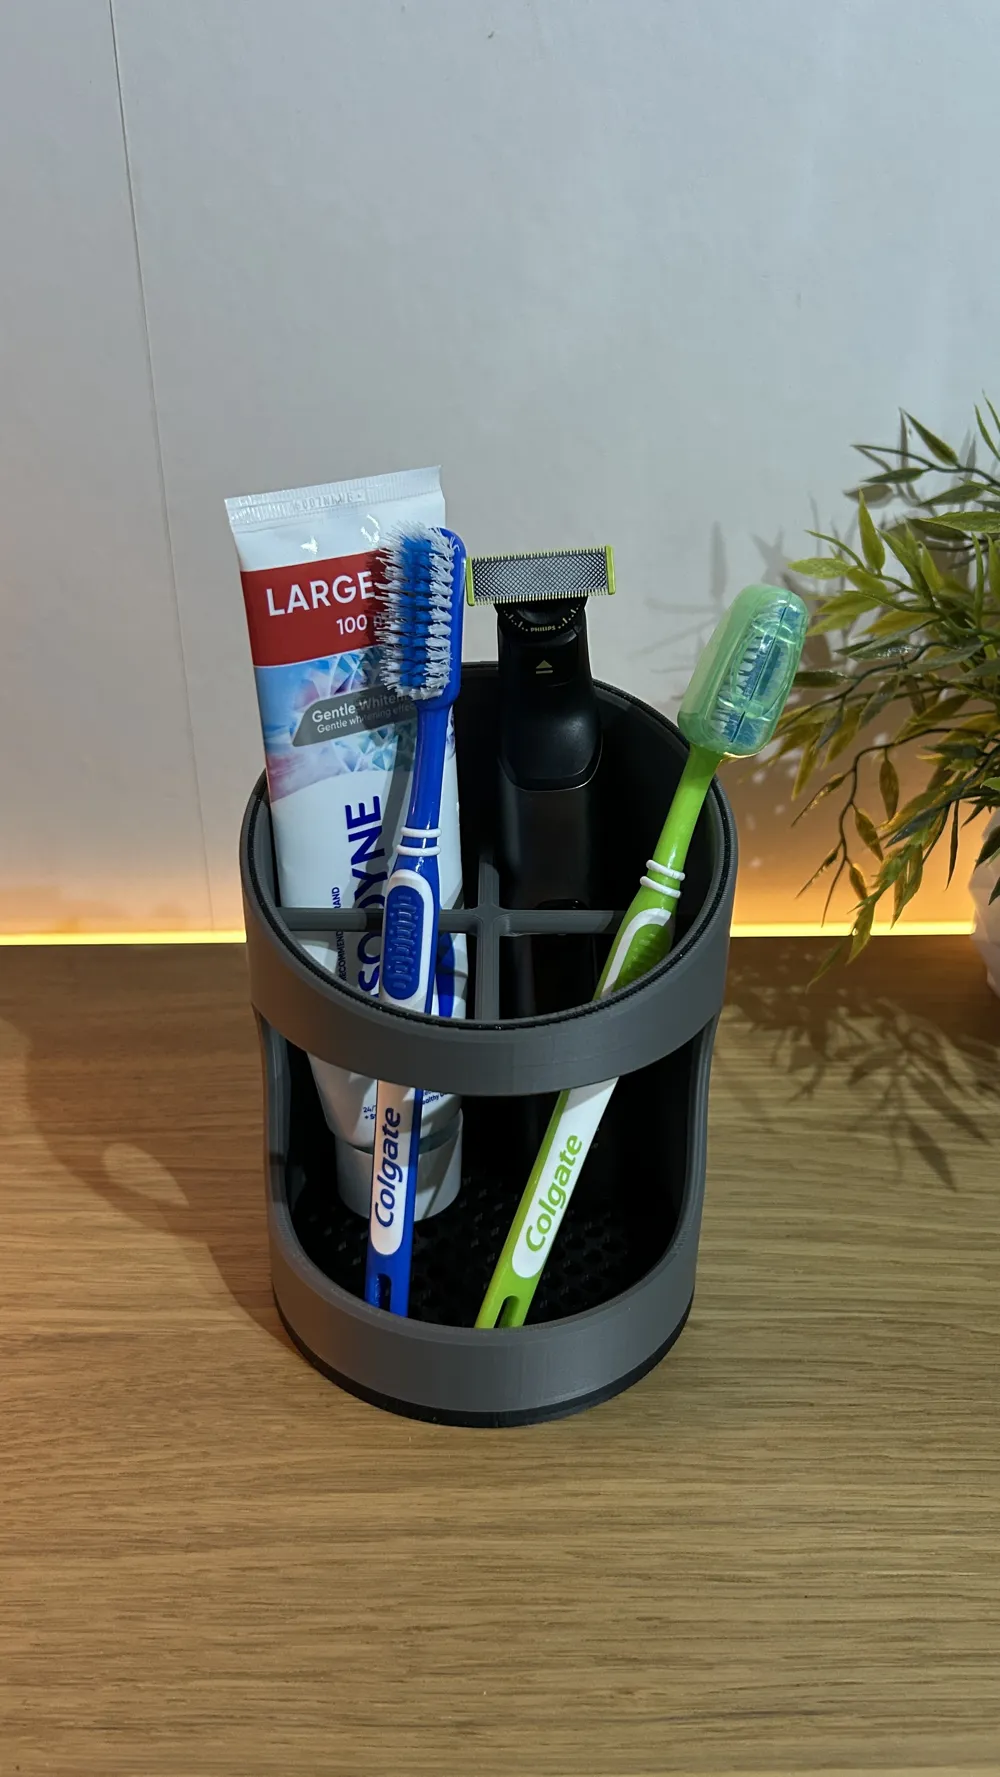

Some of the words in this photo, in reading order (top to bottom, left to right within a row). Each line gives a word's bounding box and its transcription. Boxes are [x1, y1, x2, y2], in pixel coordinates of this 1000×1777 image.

[266, 571, 376, 617] LARGE
[336, 614, 368, 635] 100
[530, 625, 556, 633] PHILIPS
[312, 703, 356, 723] Gentle
[317, 719, 348, 733] Gentle
[374, 1107, 404, 1228] Colgate
[525, 1134, 583, 1252] Colgate
